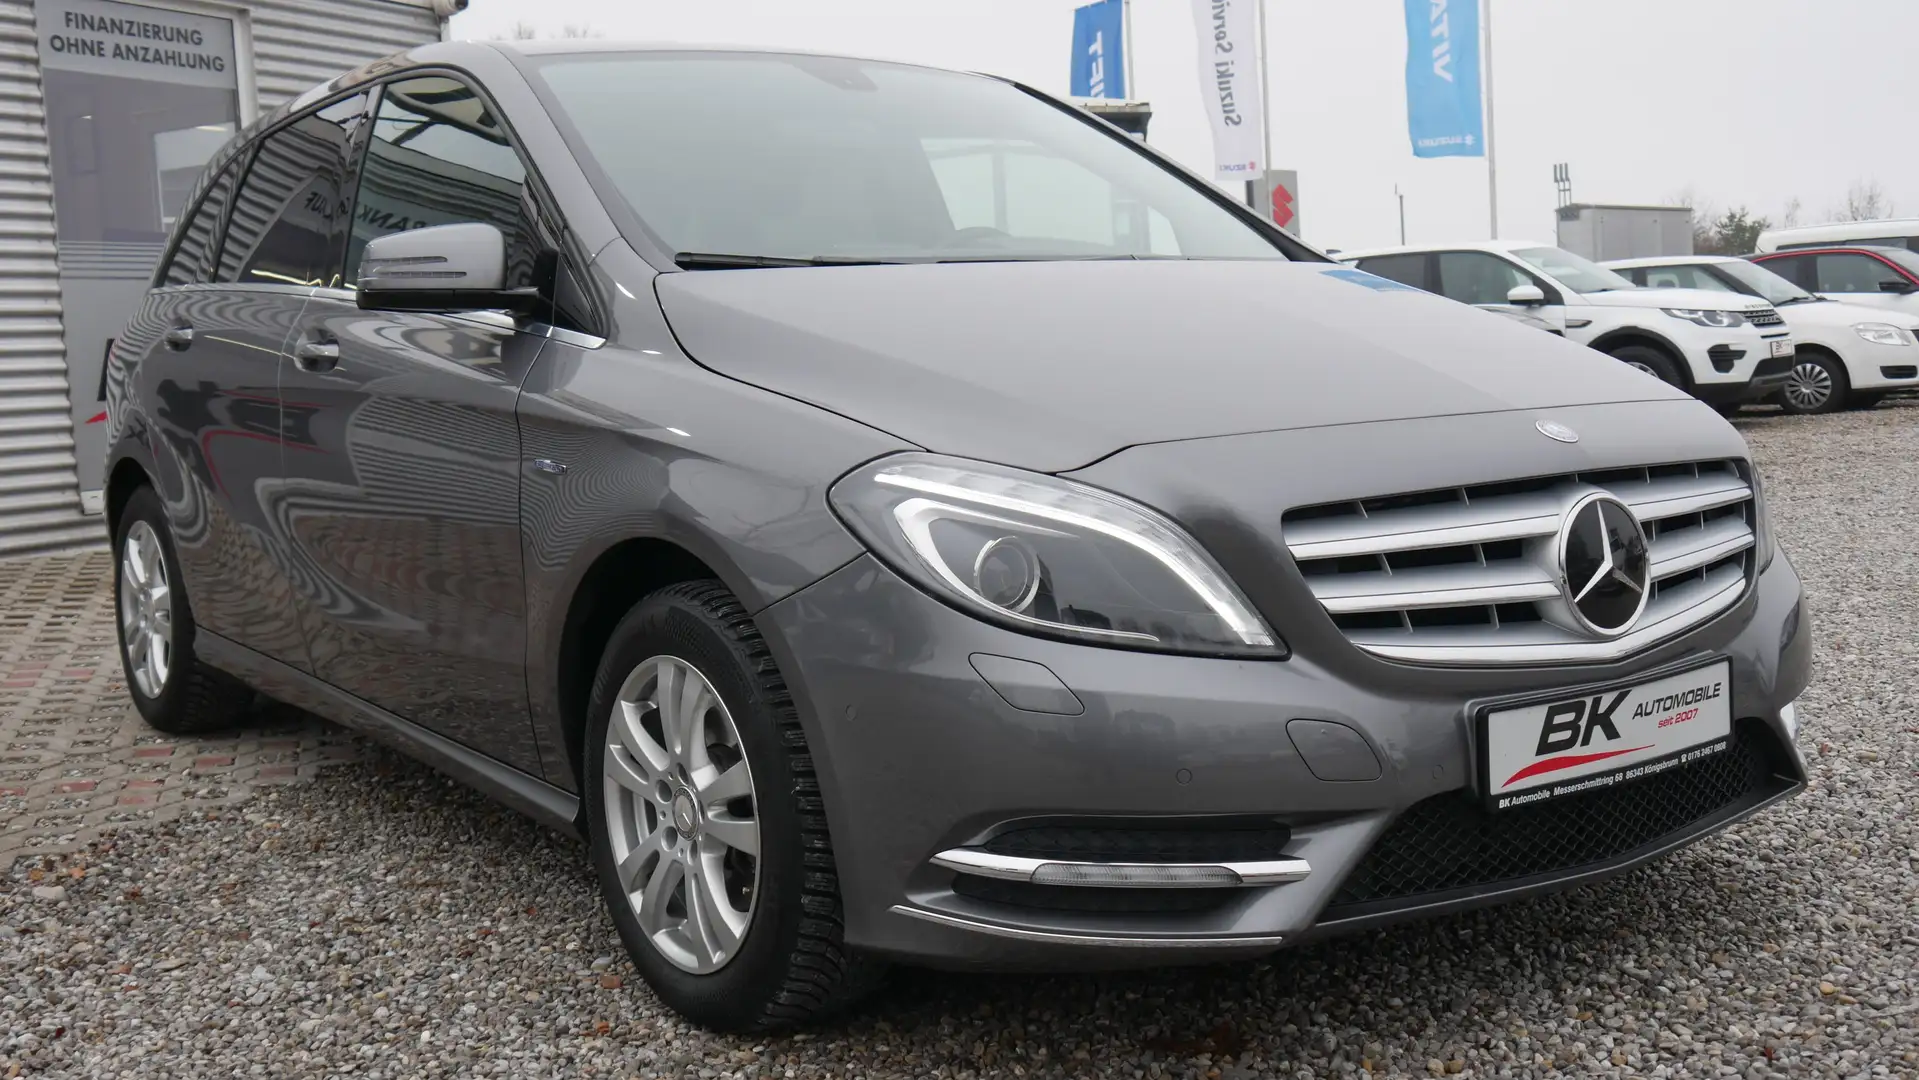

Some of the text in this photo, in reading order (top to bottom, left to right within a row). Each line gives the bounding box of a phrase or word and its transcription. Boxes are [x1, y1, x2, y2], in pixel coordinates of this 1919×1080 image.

[64, 11, 204, 46] FINANZIERUNG
[50, 34, 225, 73] OHNE ANZAHLUNG
[1535, 682, 1722, 757] BK AUTOMOBILE
[1658, 708, 1699, 729] seit 2007
[1498, 798, 1511, 809] BK
[1511, 789, 1551, 806] Automobile
[1553, 775, 1614, 796] Messerschmittring
[1614, 772, 1624, 782] 68
[1625, 767, 1644, 780] 86343
[1644, 758, 1679, 774] Königsbrunn
[1687, 750, 1701, 761] 0176
